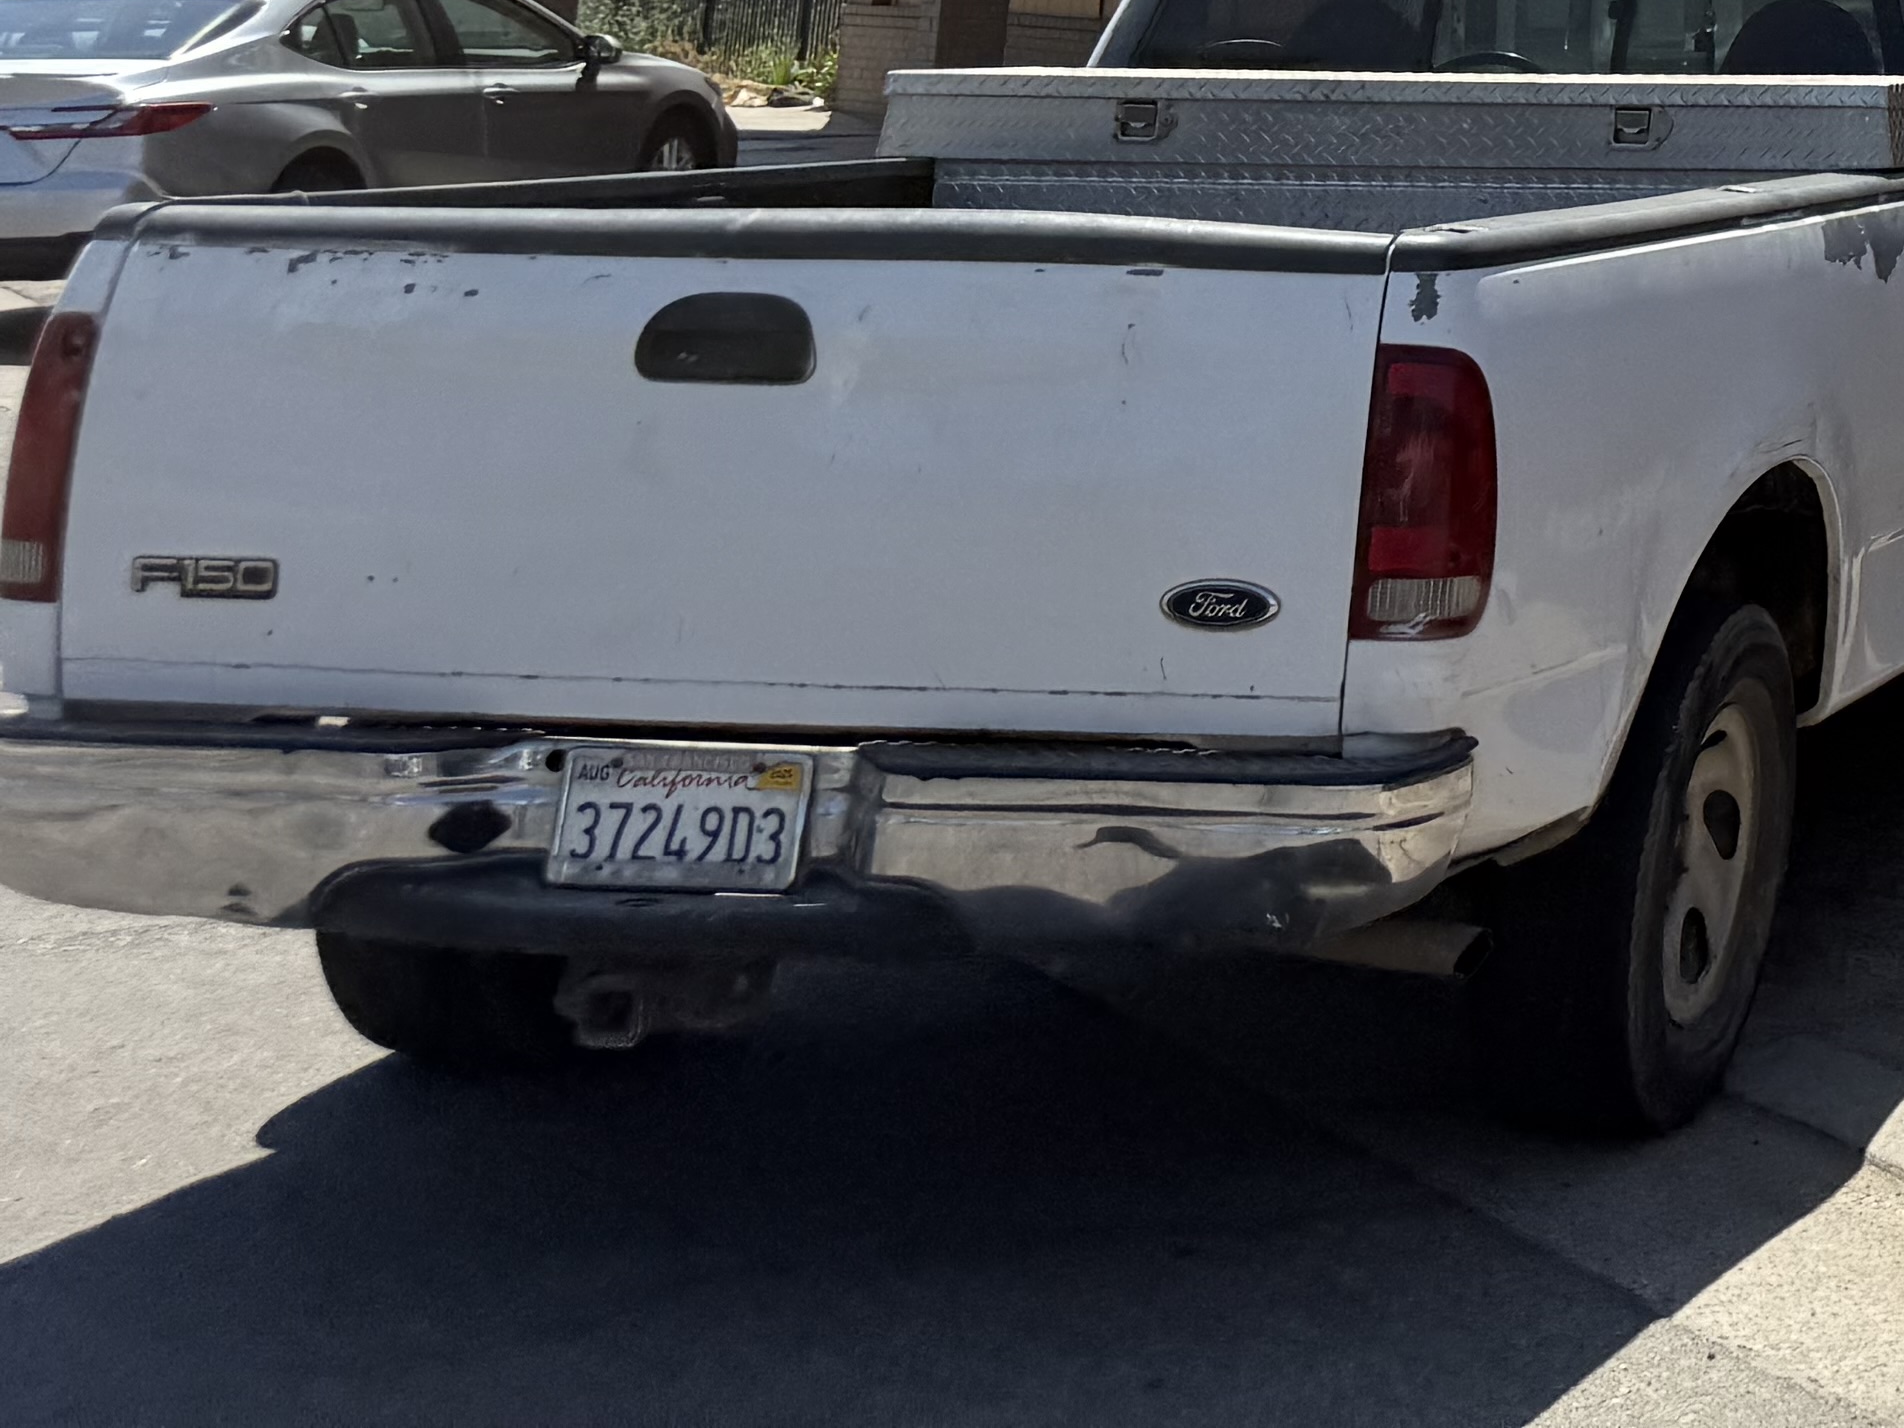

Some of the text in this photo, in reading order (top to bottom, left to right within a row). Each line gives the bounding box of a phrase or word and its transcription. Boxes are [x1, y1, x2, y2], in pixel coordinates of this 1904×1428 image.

[1188, 591, 1249, 618] Ford
[578, 763, 610, 781] AUG
[617, 768, 750, 799] California
[570, 801, 786, 865] 37249D3
